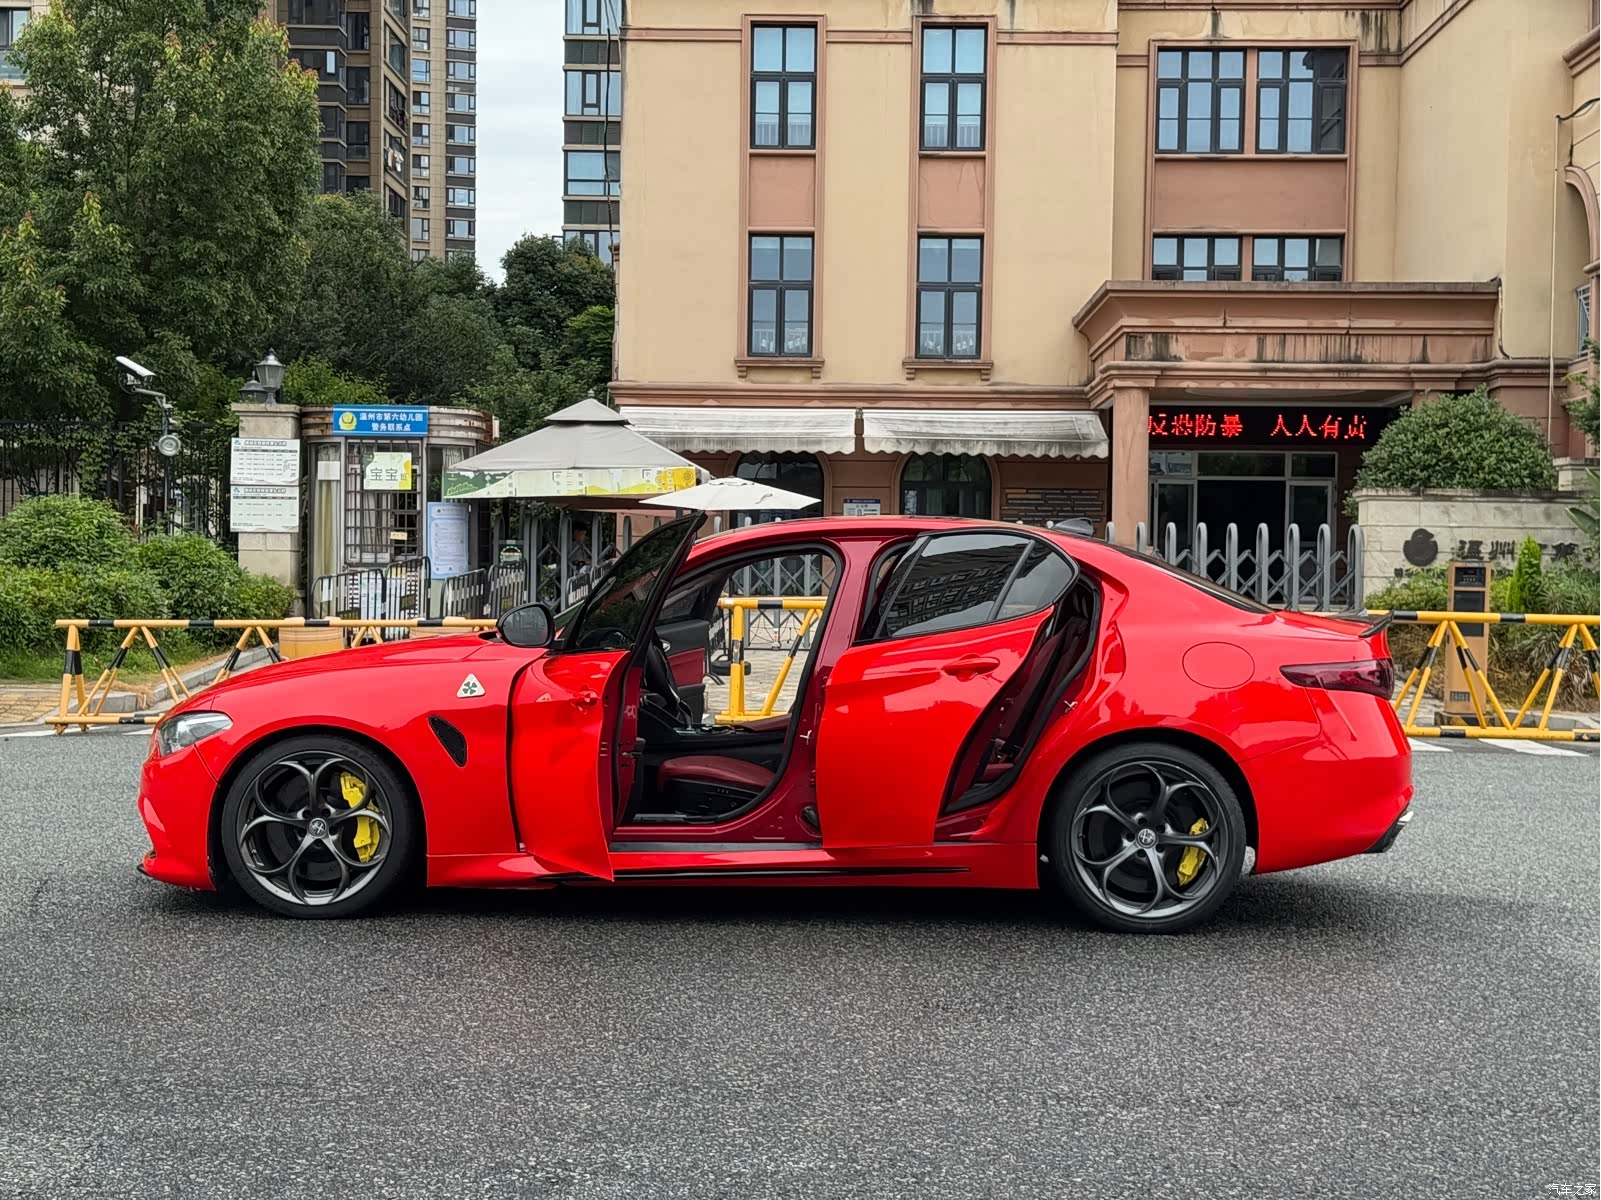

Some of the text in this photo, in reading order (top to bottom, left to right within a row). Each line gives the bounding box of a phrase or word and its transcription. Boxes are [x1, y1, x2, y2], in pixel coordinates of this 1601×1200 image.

[359, 412, 424, 422] 温州市第六幼儿园
[371, 422, 411, 432] 警务联系点
[1147, 413, 1244, 438] 反恐防暴
